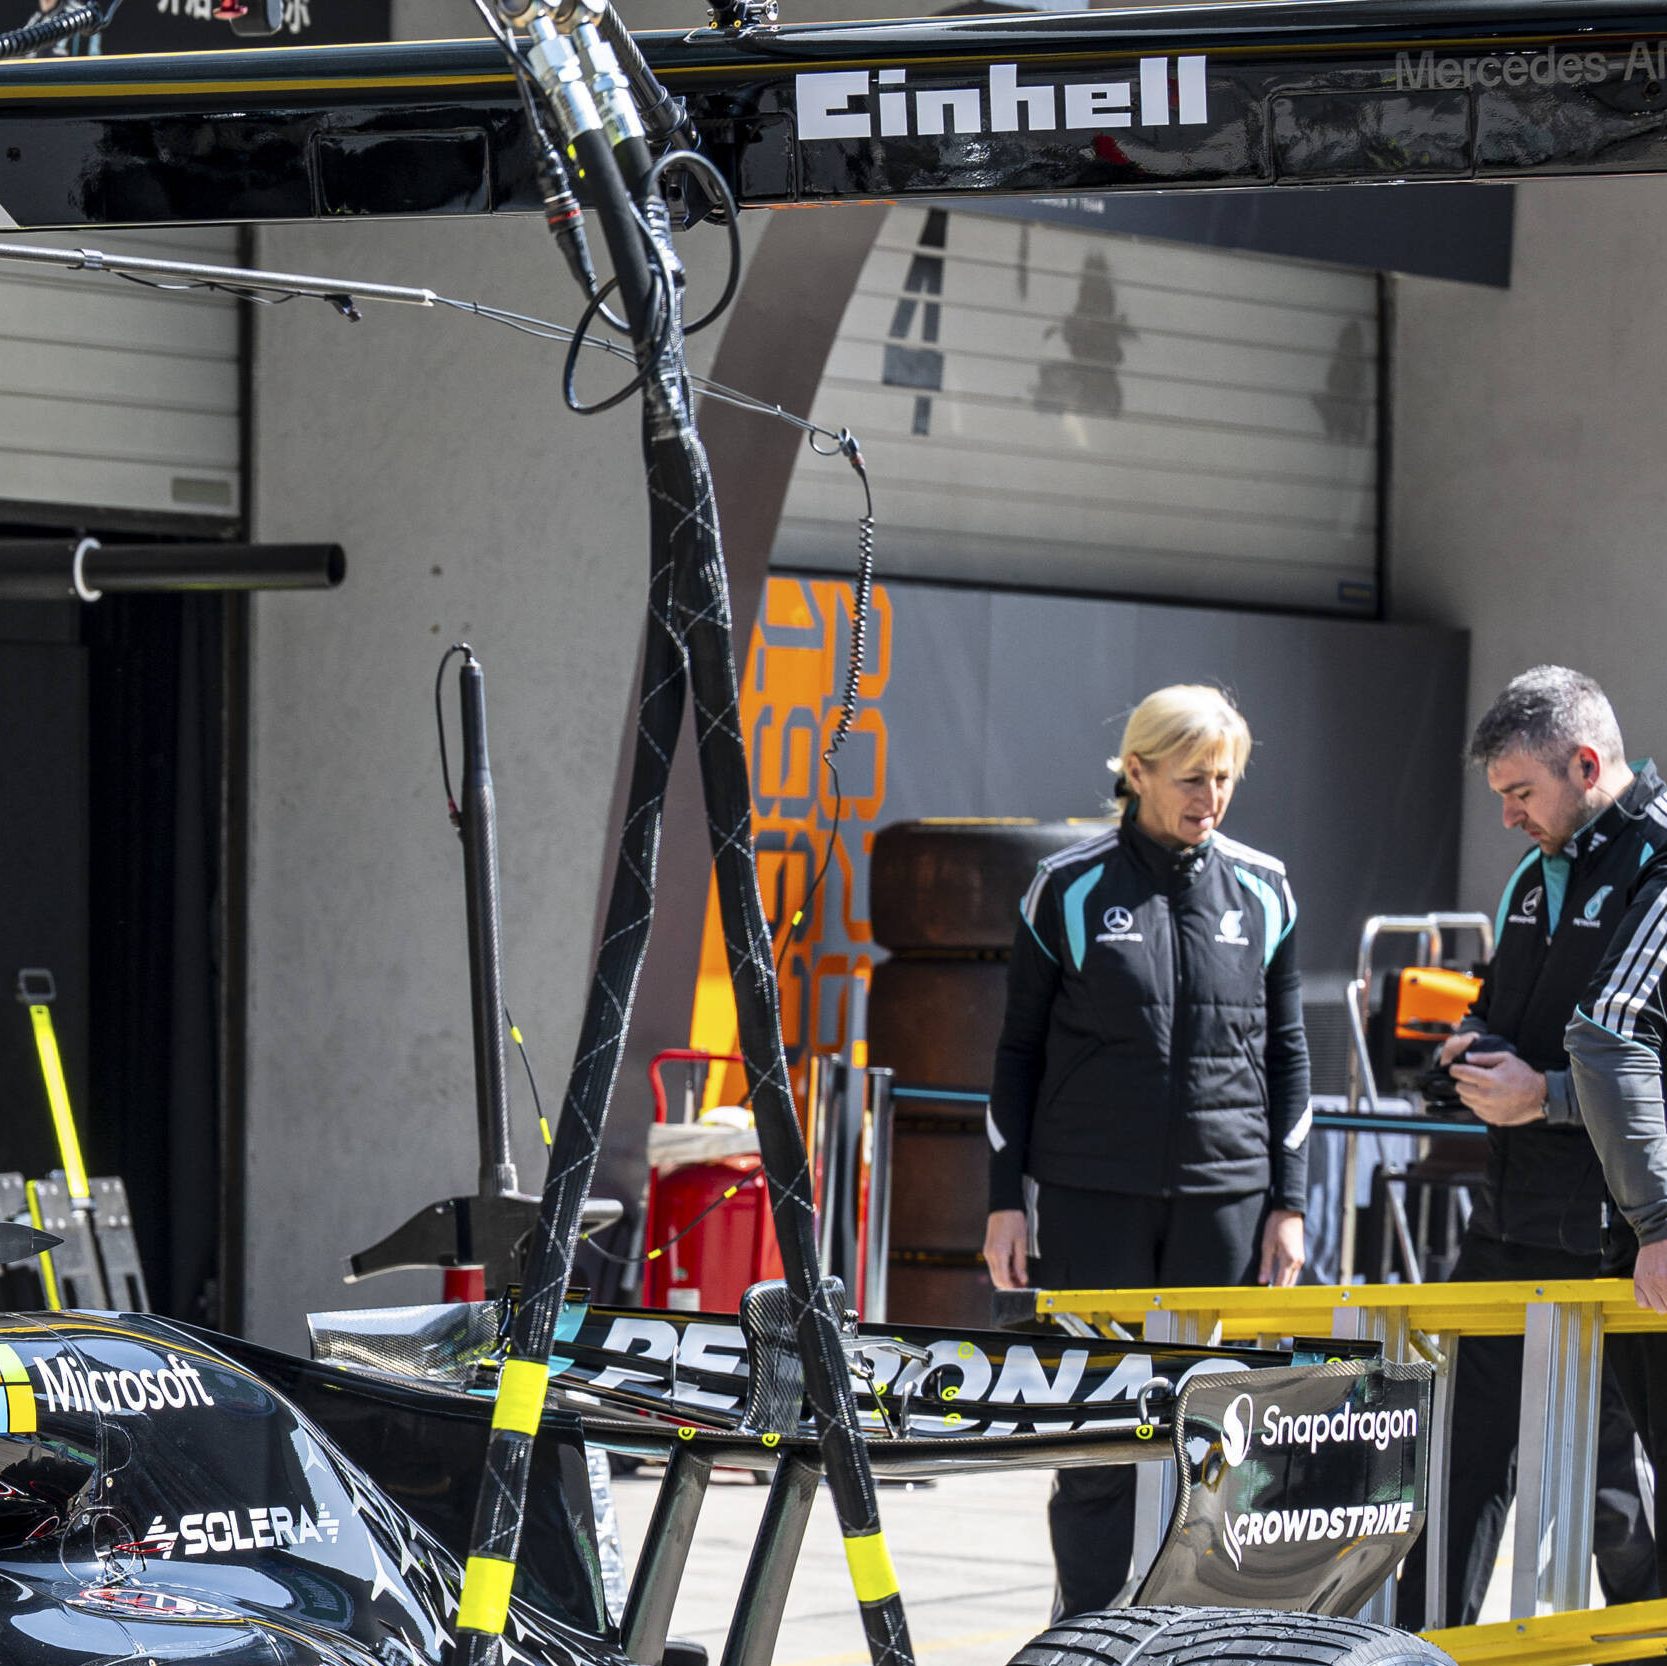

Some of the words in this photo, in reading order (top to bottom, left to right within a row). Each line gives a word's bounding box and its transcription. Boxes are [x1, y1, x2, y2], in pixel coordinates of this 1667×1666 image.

[1395, 40, 1667, 93] Mercedes-A
[795, 55, 1207, 140] Einhell
[33, 1354, 215, 1413] Microsoft
[1261, 1401, 1417, 1454] Snapdragon
[181, 1505, 324, 1556] SOLERA
[1233, 1501, 1413, 1546] CROWDSTRIKE
